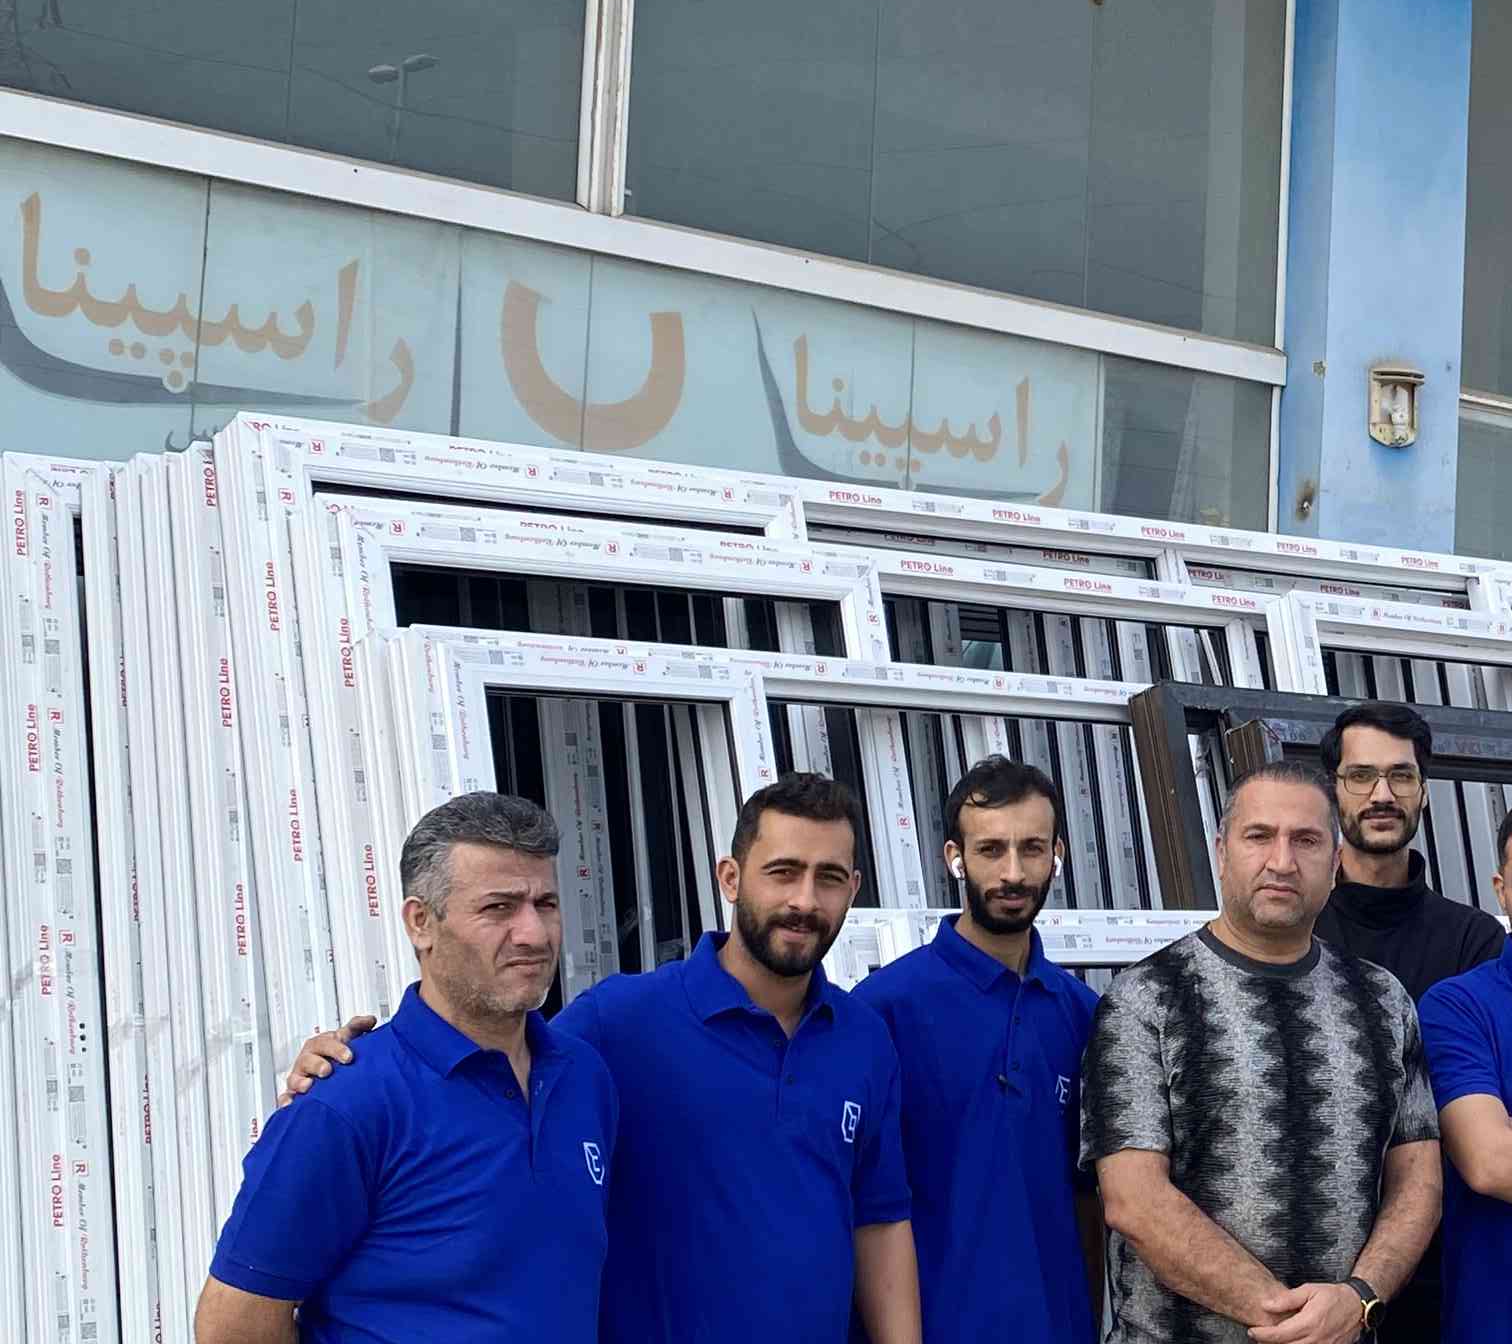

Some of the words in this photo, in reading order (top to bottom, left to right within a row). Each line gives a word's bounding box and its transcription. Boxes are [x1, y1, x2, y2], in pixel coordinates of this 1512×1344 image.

[20, 192, 414, 423] راسپینا
[794, 334, 1069, 507] راسپینا
[205, 467, 216, 507] PETRO
[830, 491, 861, 503] PETRO
[992, 509, 1020, 520] PETRO
[1141, 527, 1167, 538] PETRO
[16, 518, 27, 557] PETRO
[901, 560, 932, 572] PETRO
[1064, 577, 1092, 590] PETRO
[267, 592, 280, 631] PETRO
[1212, 595, 1238, 607] PETRO
[342, 648, 355, 688] PETRO
[220, 688, 233, 728] PETRO
[28, 732, 39, 772] PETRO
[291, 819, 303, 862] PETRO
[366, 876, 379, 916] PETRO
[236, 915, 247, 956] PETRO
[52, 1184, 64, 1228] PETRO
